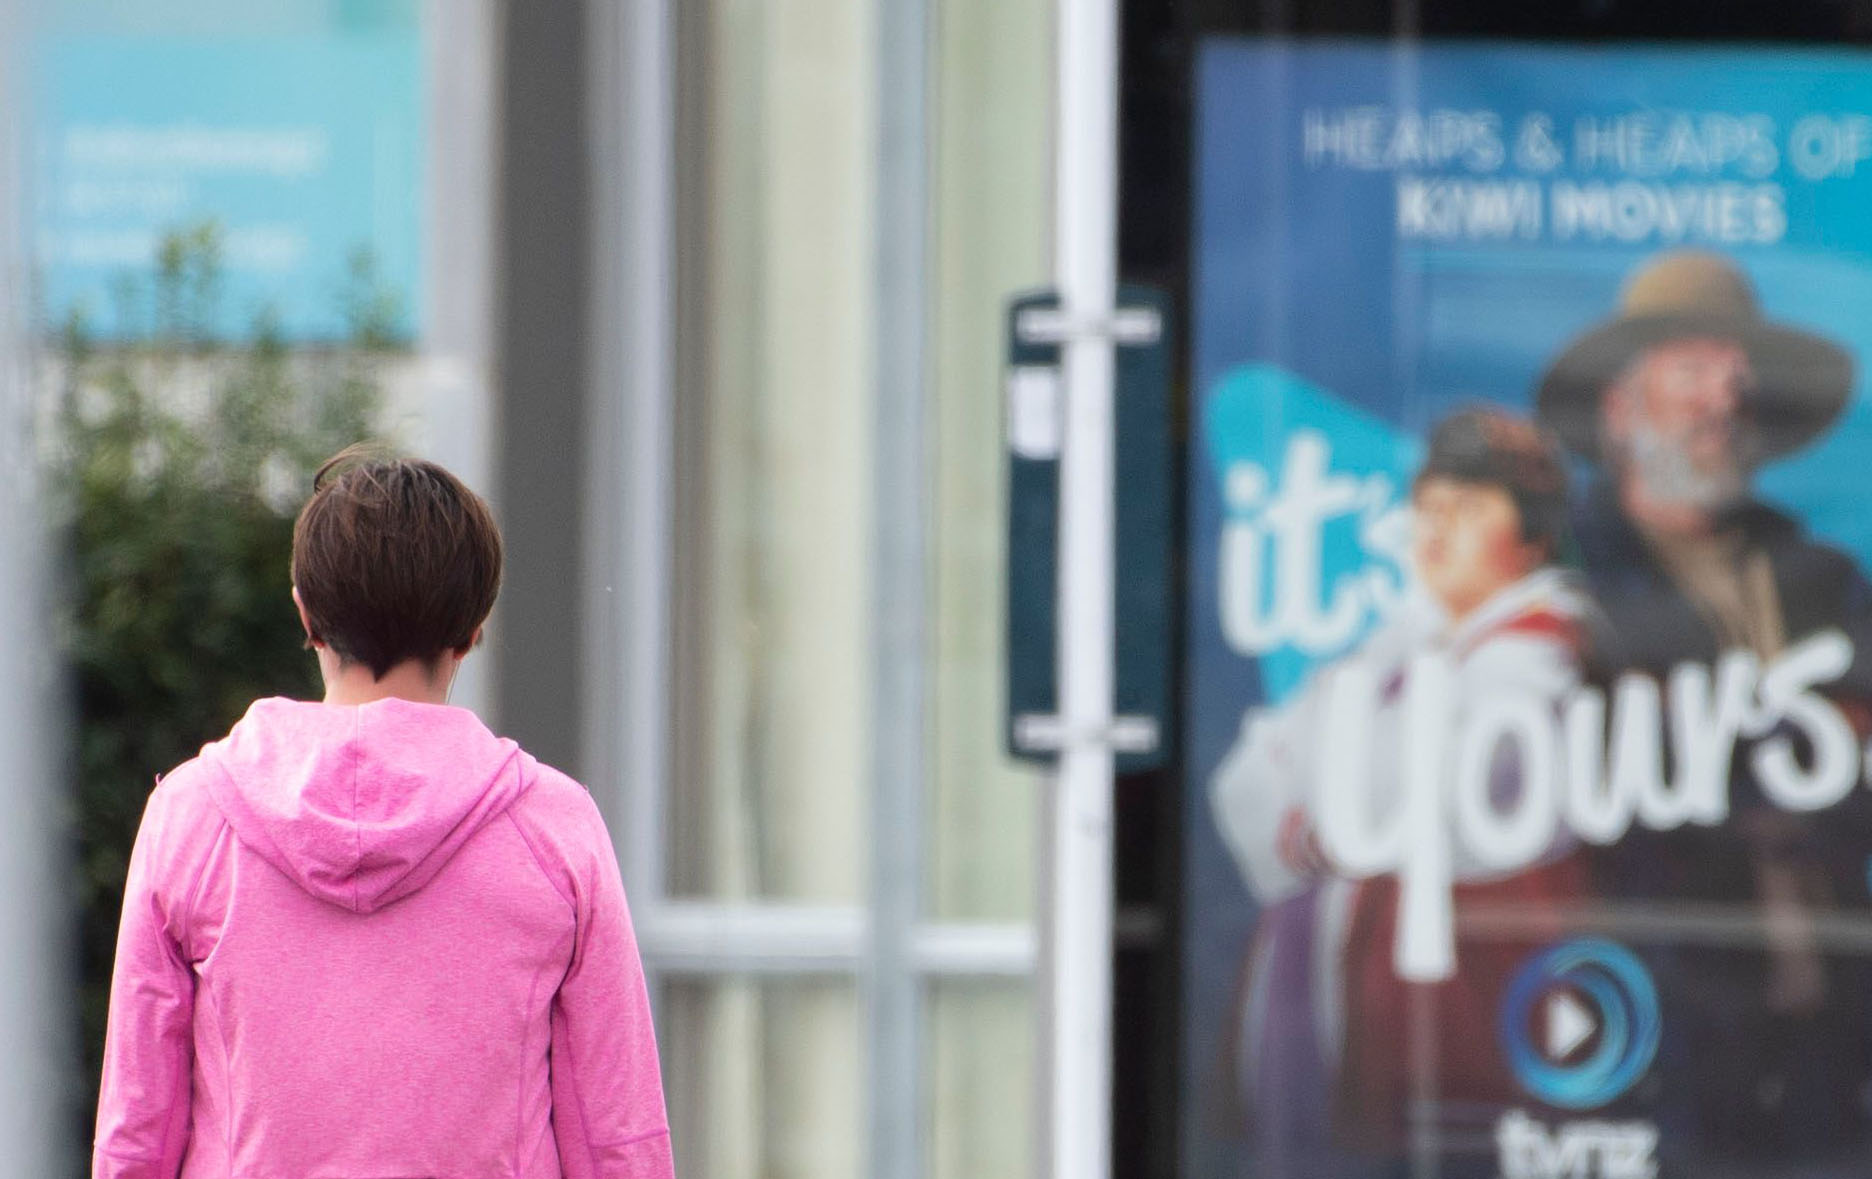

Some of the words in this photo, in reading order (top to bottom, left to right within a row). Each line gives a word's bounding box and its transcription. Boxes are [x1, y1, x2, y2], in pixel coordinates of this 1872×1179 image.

[1303, 107, 1505, 172] HEAPS
[1515, 111, 1564, 173] &
[1574, 111, 1779, 177] HEAPS
[1398, 181, 1542, 238] KIWI
[1552, 181, 1788, 243] MOVIES
